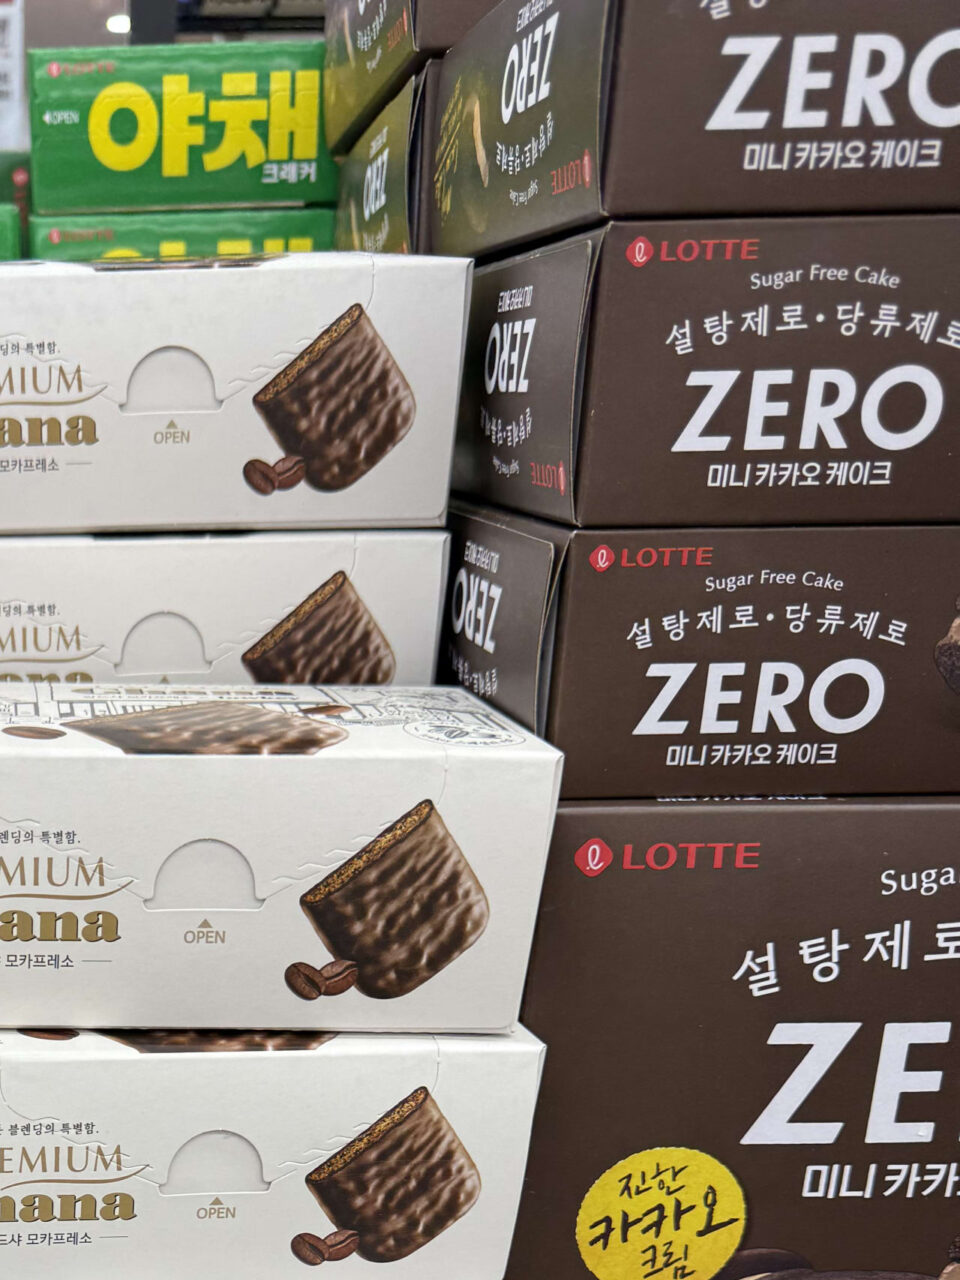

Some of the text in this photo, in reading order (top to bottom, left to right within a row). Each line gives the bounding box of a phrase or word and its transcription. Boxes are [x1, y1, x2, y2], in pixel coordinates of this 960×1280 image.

[88, 69, 320, 177] 야채
[744, 140, 941, 171] 미니 카카오 케이크
[660, 240, 759, 262] LOTTE
[751, 264, 900, 290] Sugar Free Cake
[485, 318, 536, 394] ZERO
[671, 365, 943, 452] ZERO
[153, 431, 190, 445] OPEN
[707, 461, 891, 488] 미니 카카오 케이크
[621, 547, 713, 568] LOTTE
[705, 570, 844, 592] Sugar Free Cake
[632, 658, 885, 735] ZERO
[666, 744, 837, 767] 미니 카카오 케이크
[622, 843, 761, 870] LOTTE
[184, 930, 225, 944] OPEN
[6, 952, 74, 968] 모카프레소
[619, 1164, 688, 1199] 진한
[196, 1207, 236, 1220] OPEN
[589, 1186, 740, 1250] 카카오
[25, 1231, 93, 1246] 모카프레소
[642, 1245, 697, 1280] 크림
